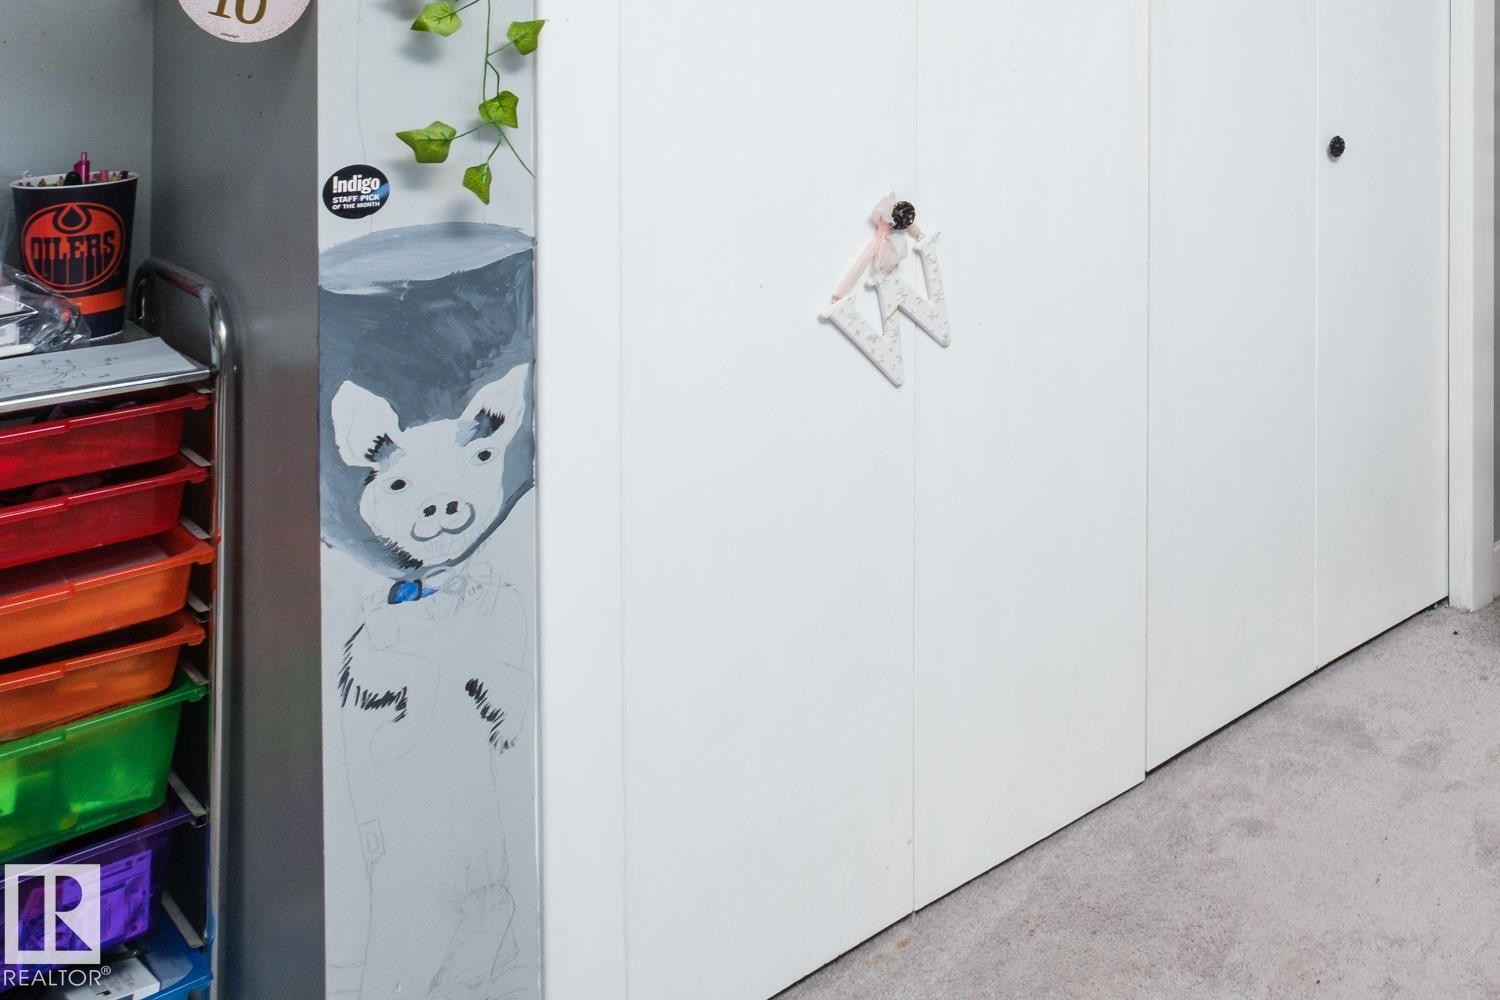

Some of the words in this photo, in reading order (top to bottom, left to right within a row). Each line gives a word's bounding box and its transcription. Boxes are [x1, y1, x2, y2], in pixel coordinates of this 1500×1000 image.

[332, 195, 359, 204] STAFF
[360, 194, 380, 202] PICK
[356, 201, 380, 209] MONTH
[30, 230, 115, 269] OILERS
